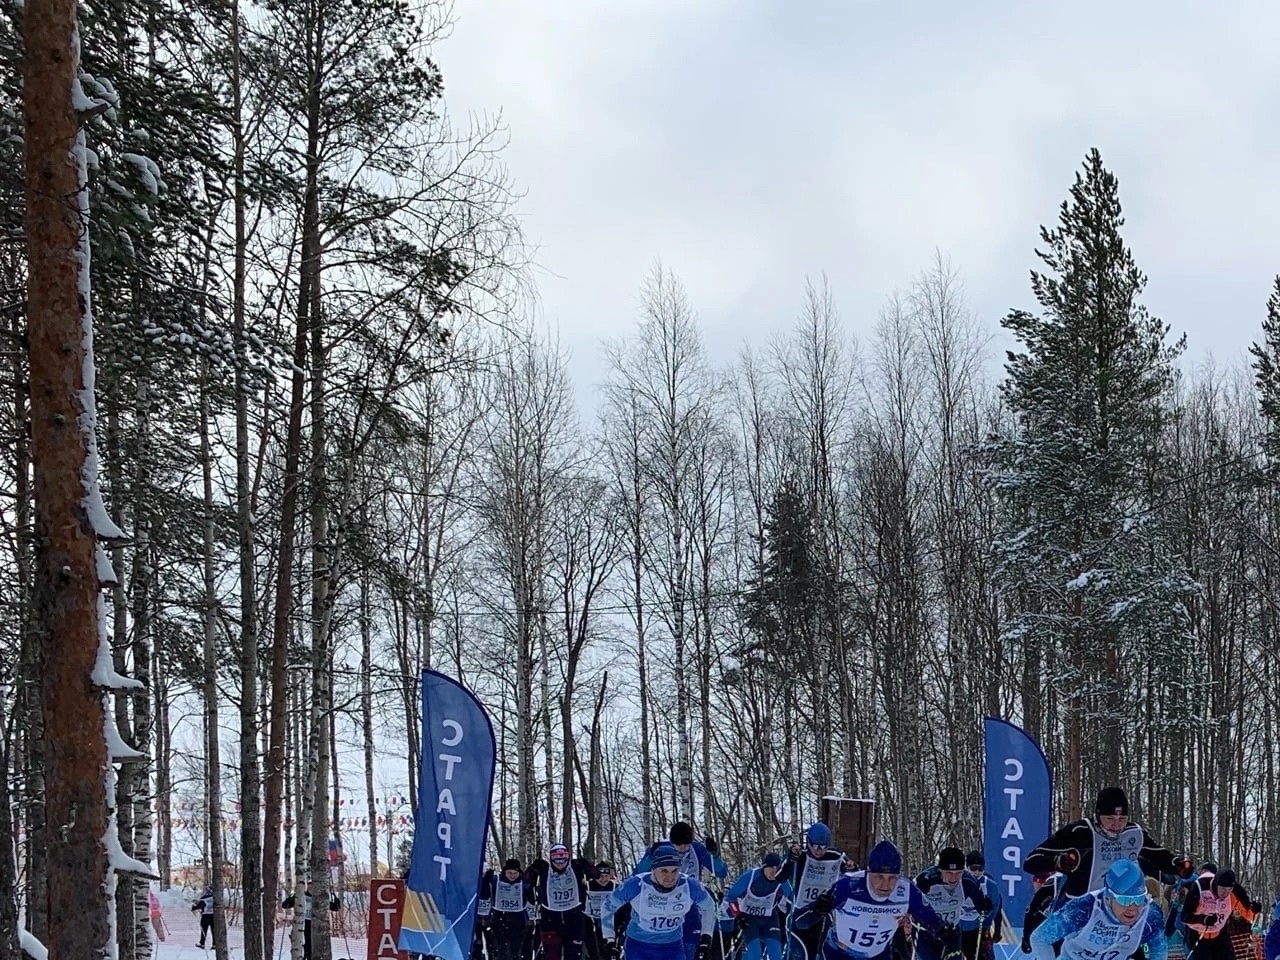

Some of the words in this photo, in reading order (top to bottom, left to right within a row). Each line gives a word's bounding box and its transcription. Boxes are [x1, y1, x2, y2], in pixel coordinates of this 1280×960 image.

[553, 888, 574, 901] 1797
[501, 900, 519, 908] 1954
[851, 905, 901, 914] НОВОДВИНСК
[848, 927, 892, 947] 153
